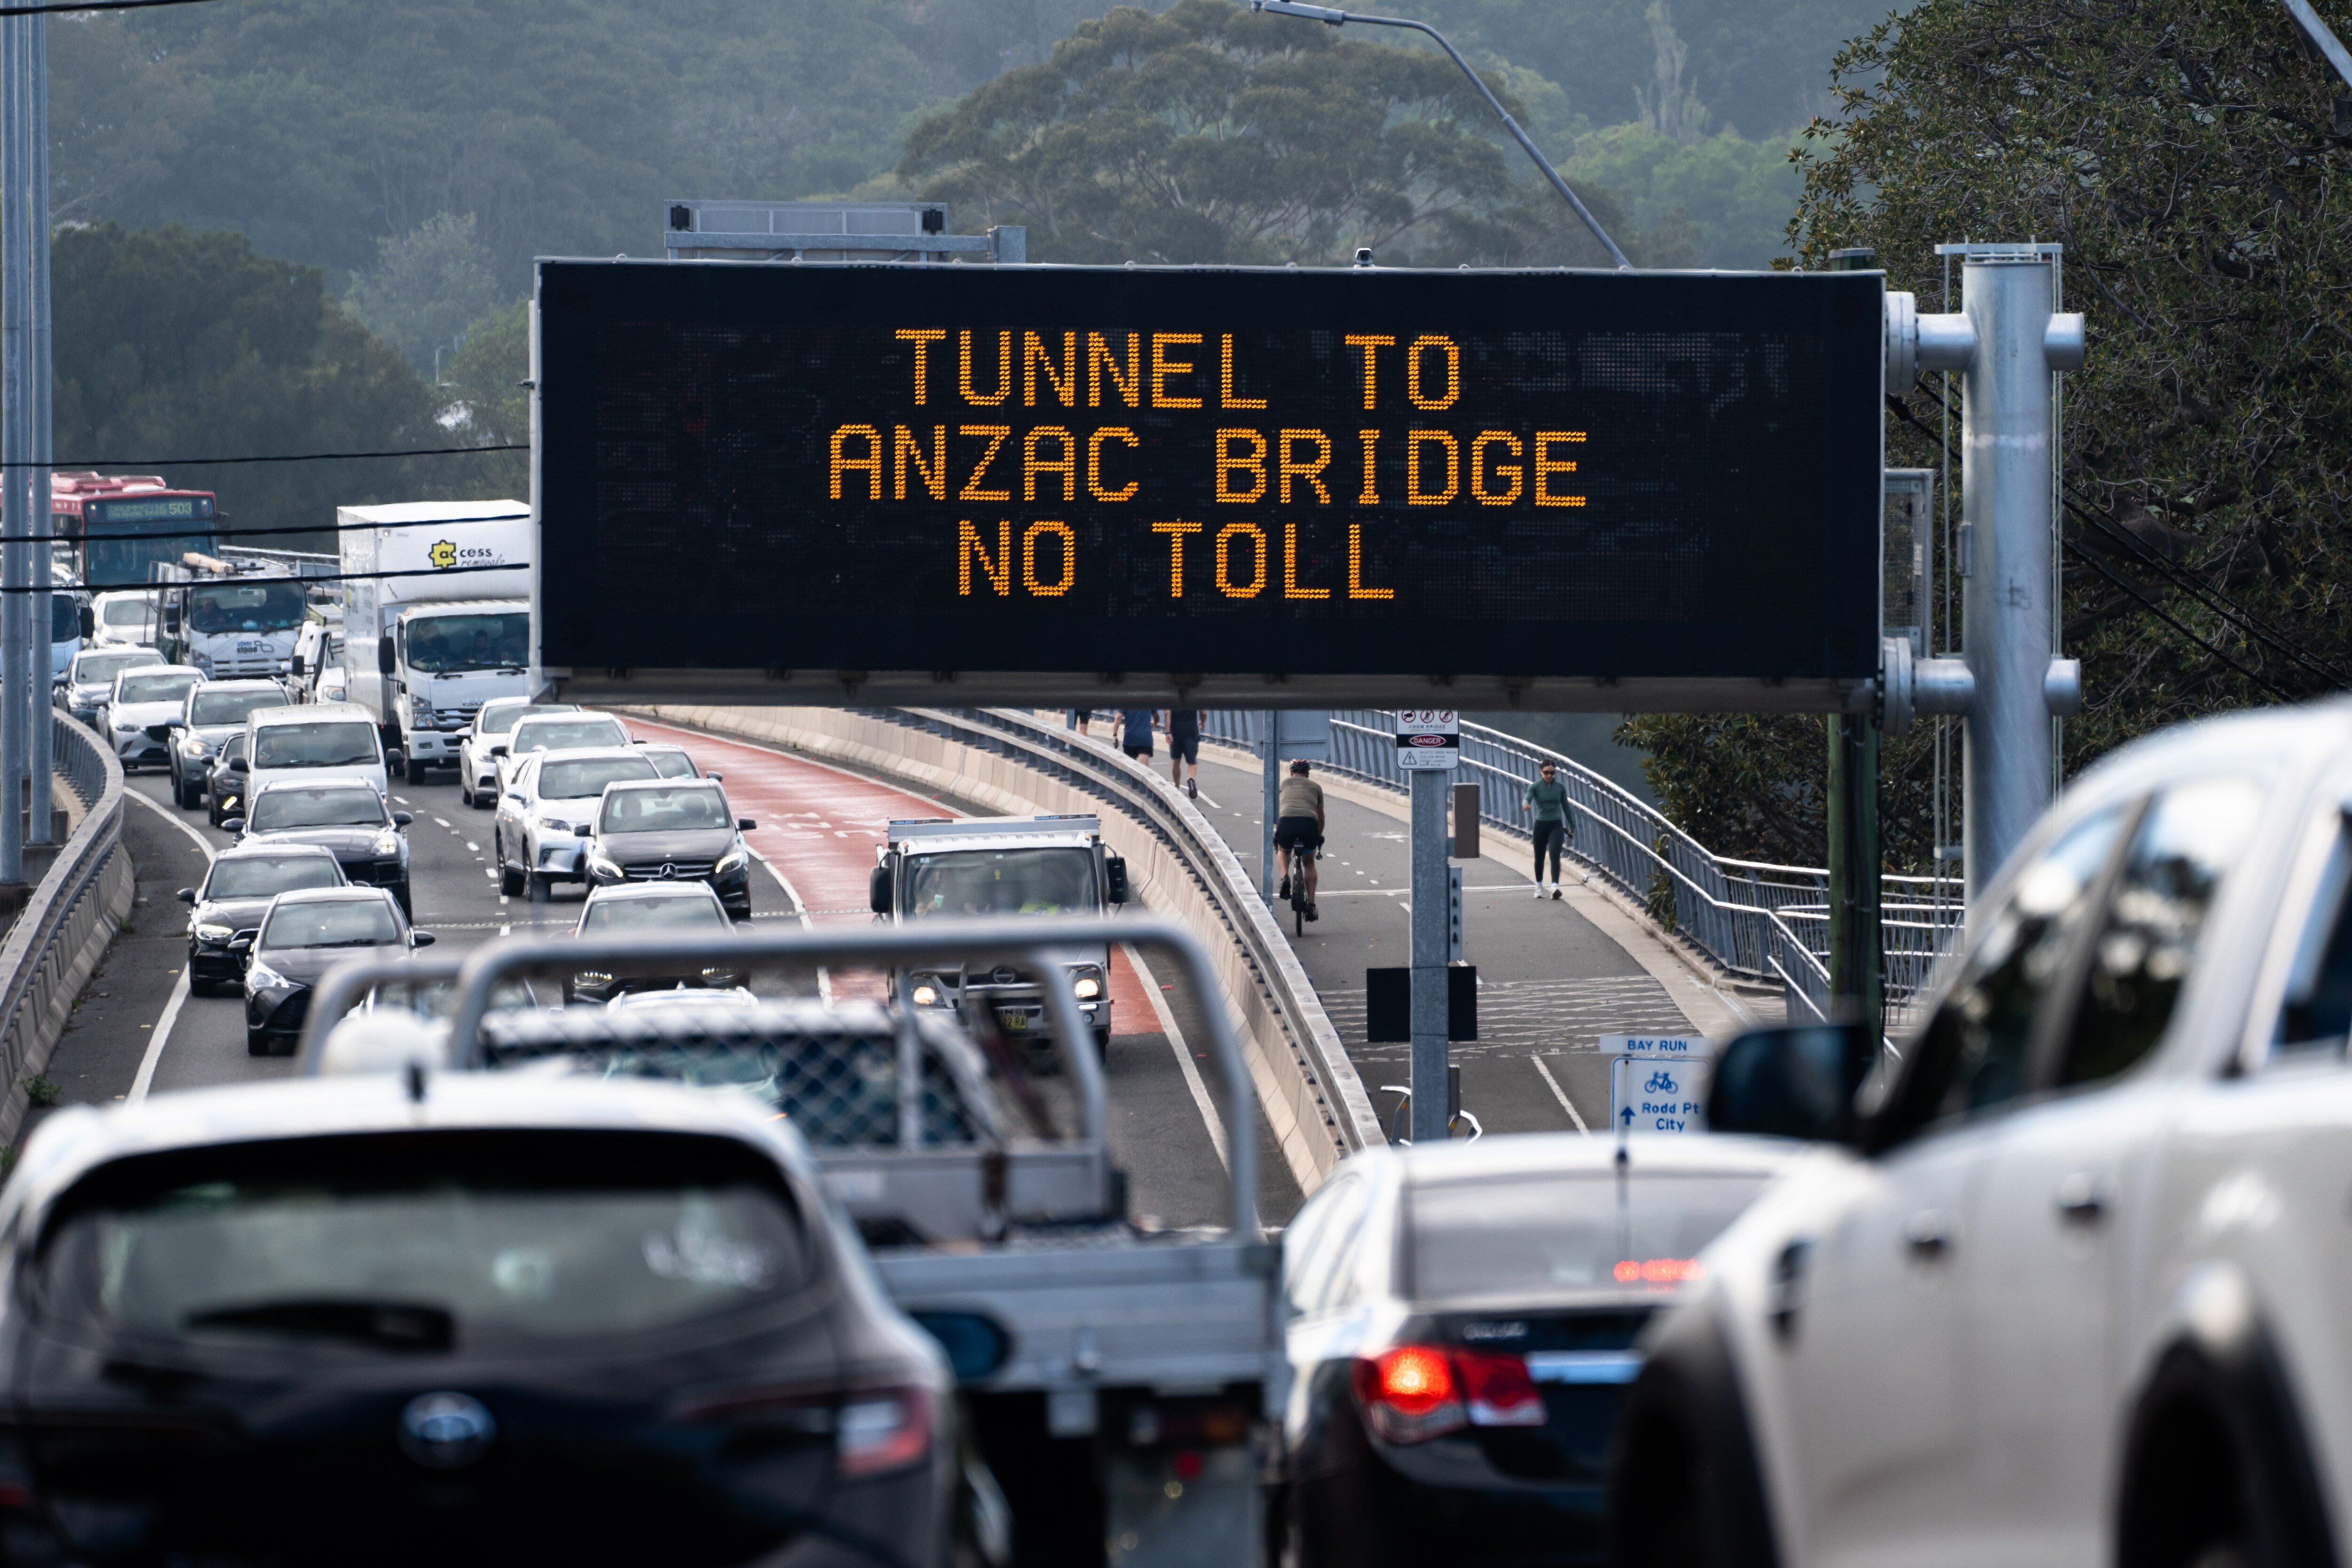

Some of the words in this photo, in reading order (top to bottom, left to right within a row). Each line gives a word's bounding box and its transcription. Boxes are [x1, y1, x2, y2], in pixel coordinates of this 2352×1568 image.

[895, 329, 1268, 409] TUNNEL
[1345, 334, 1460, 410] TO
[829, 424, 1140, 502] ANZAC
[1216, 428, 1587, 507] BRIDGE
[168, 502, 192, 515] 503
[958, 520, 1075, 597] NO
[1152, 522, 1395, 600] TOLL
[1628, 1040, 1653, 1051] BAY
[1660, 1040, 1687, 1051] RUN
[1642, 1103, 1676, 1114] Rodd
[1683, 1103, 1699, 1114] Pt
[1656, 1118, 1685, 1133] City
